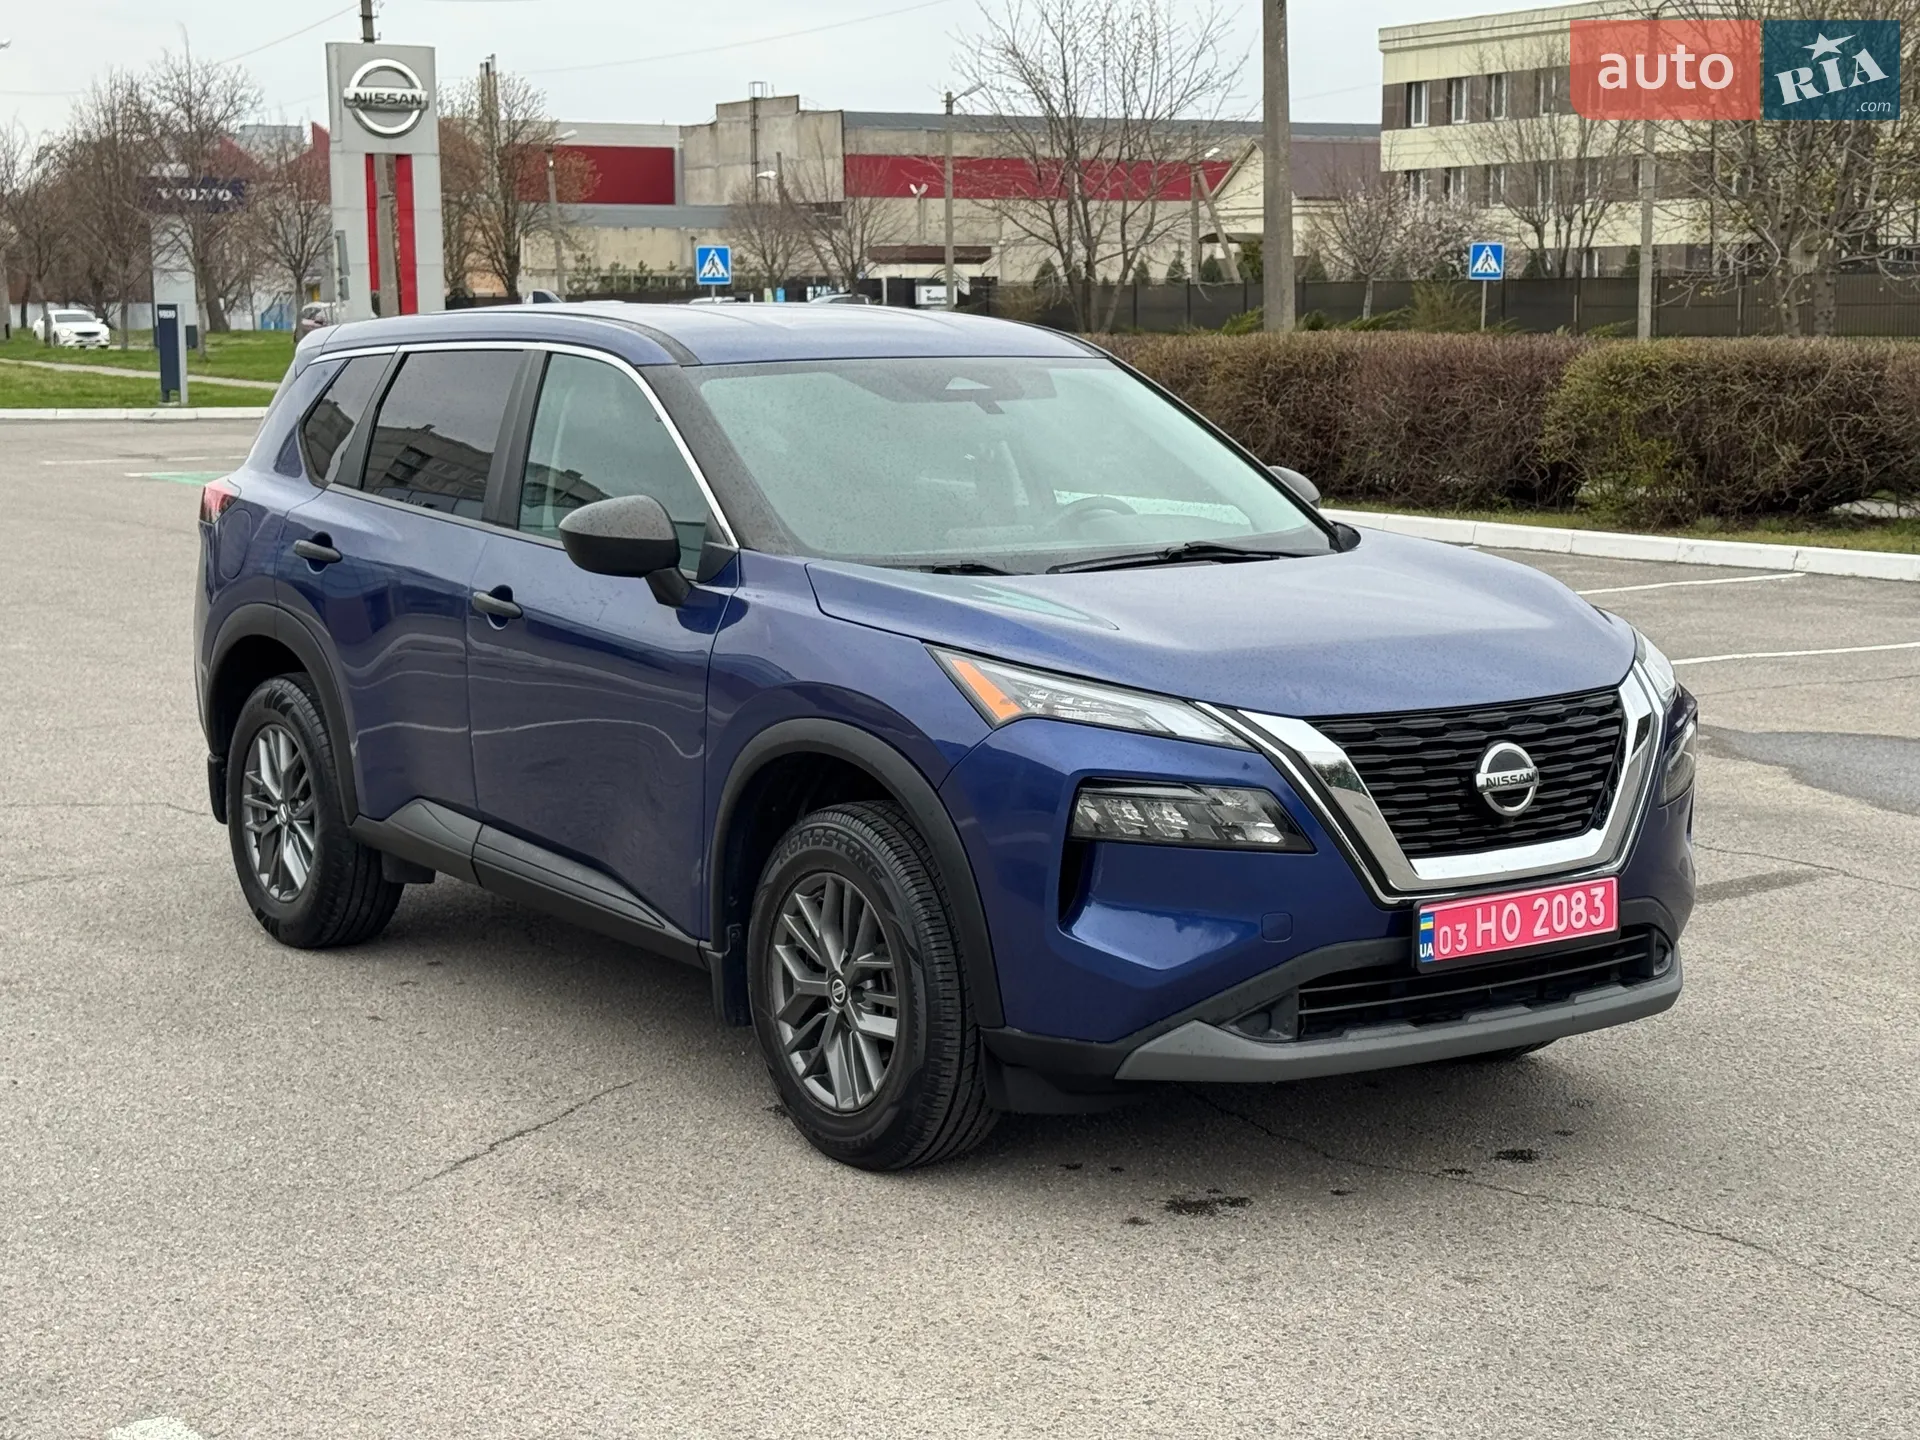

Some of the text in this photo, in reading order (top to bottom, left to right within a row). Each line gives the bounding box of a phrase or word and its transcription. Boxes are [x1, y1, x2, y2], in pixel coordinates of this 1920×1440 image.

[353, 92, 422, 105] NISSAN
[1485, 771, 1535, 787] NISSAN
[779, 829, 887, 882] ROADSTONE
[1439, 923, 1467, 955] 03
[1532, 886, 1605, 937] 2083
[1419, 942, 1434, 958] UA
